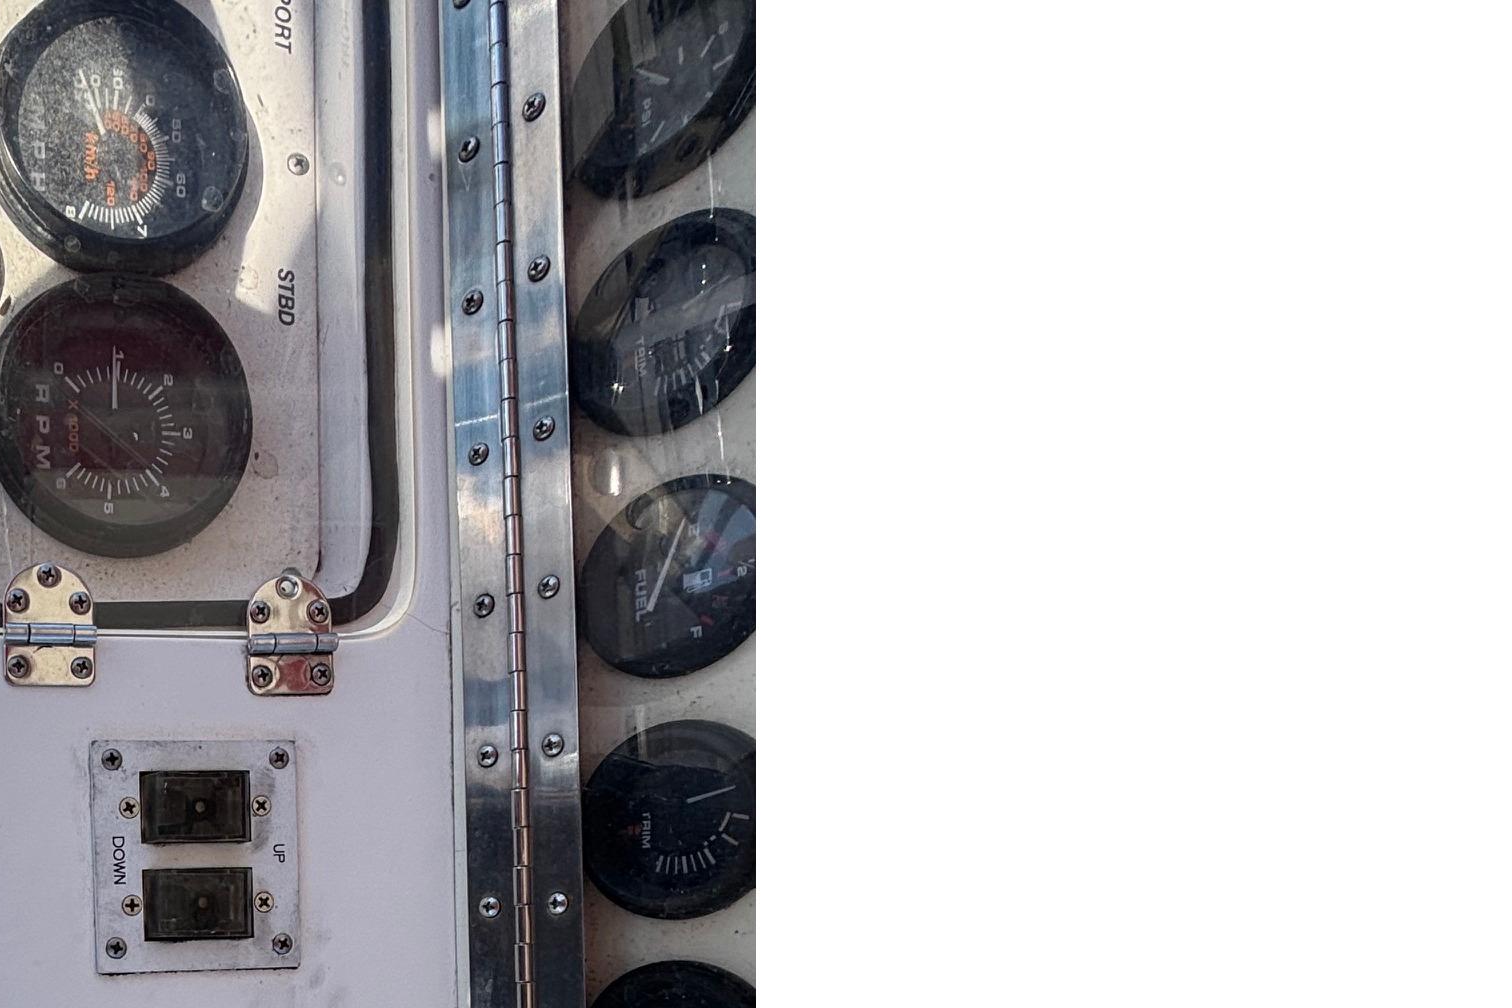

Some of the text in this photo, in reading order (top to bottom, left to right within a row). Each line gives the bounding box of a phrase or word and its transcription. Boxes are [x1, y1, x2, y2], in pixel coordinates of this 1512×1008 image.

[84, 132, 100, 181] km/h
[147, 151, 156, 171] 90
[107, 181, 116, 206] 120
[176, 173, 186, 198] 60
[277, 268, 295, 326] STBD
[54, 362, 63, 375] 0
[163, 374, 174, 386] 2
[68, 415, 79, 453] 1000
[183, 427, 193, 440] 3
[56, 477, 66, 490] 6
[160, 486, 170, 498] 4
[104, 502, 113, 514] 5
[635, 568, 647, 622] FUEL
[690, 625, 703, 638] F
[112, 836, 126, 885] DOWN
[273, 843, 285, 863] UP
